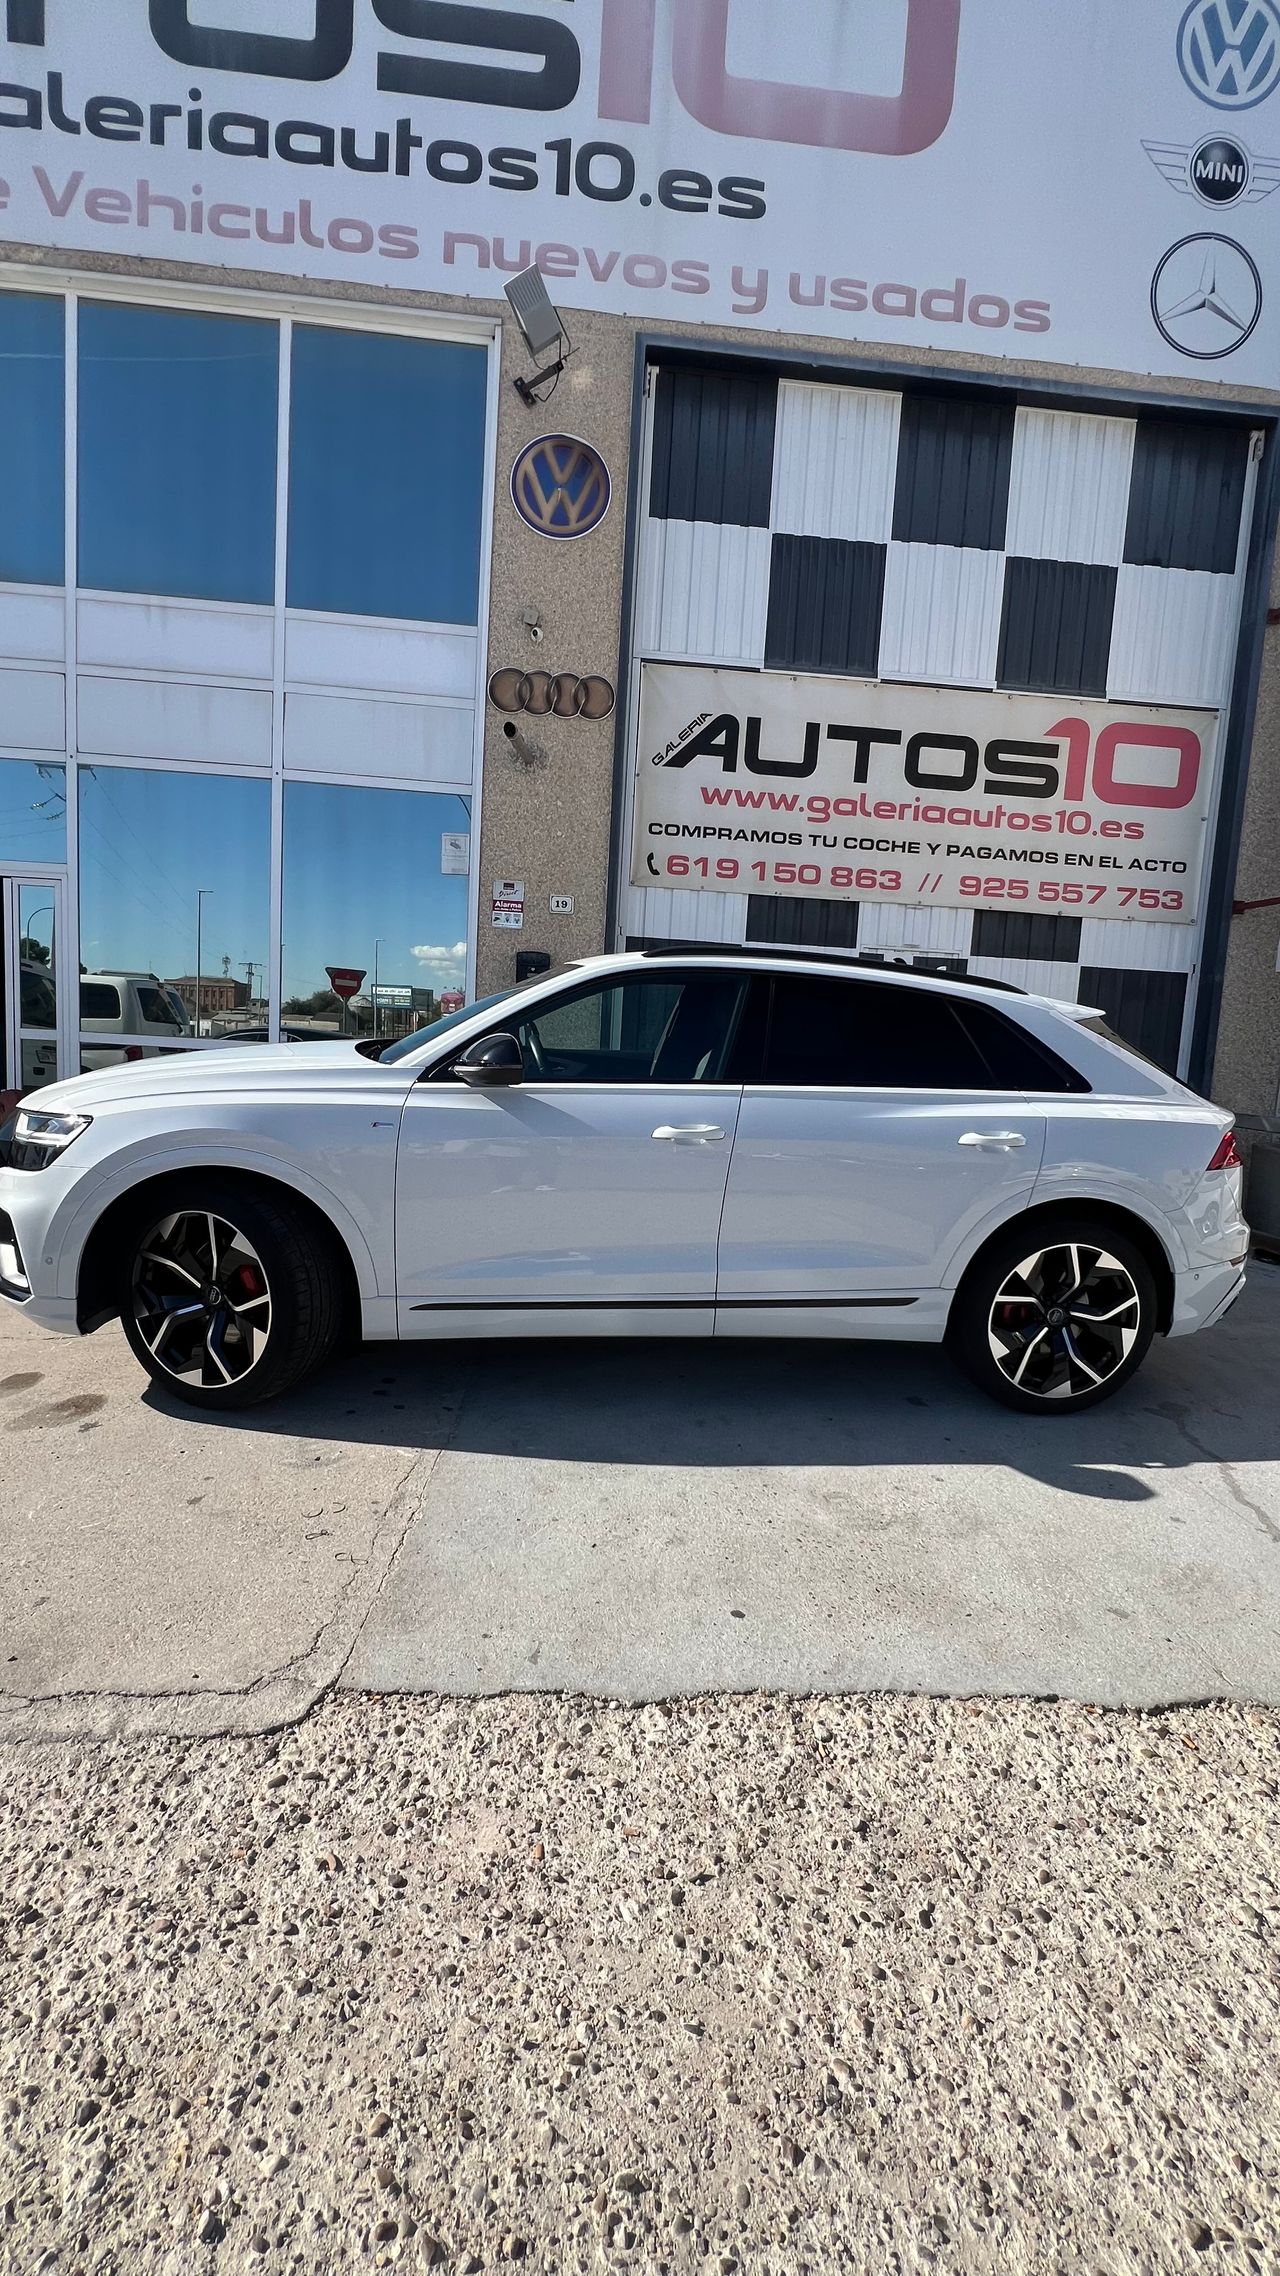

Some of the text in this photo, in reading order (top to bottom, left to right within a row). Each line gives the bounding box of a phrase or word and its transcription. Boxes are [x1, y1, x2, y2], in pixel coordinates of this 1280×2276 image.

[7, 0, 961, 156] OS10
[1196, 159, 1244, 183] MINI
[32, 165, 420, 260] Vehiculos
[443, 230, 710, 295] nuevos
[731, 265, 768, 314] y
[788, 274, 1052, 333] usados
[651, 712, 713, 766] GALERIA
[662, 713, 1201, 809] AUTOS10
[700, 786, 1145, 840] www.galeriaautos10.es
[648, 822, 1187, 873] COMPRAMOS TU COCHE Y PAGAMOS EN EL ACTO
[494, 901, 522, 909] Alarma
[555, 900, 568, 909] 19
[666, 854, 740, 879] 619
[751, 860, 821, 885] 150
[830, 866, 902, 890] 863
[959, 875, 1029, 899] 925
[1037, 881, 1107, 904] 557
[1116, 887, 1184, 911] 753
